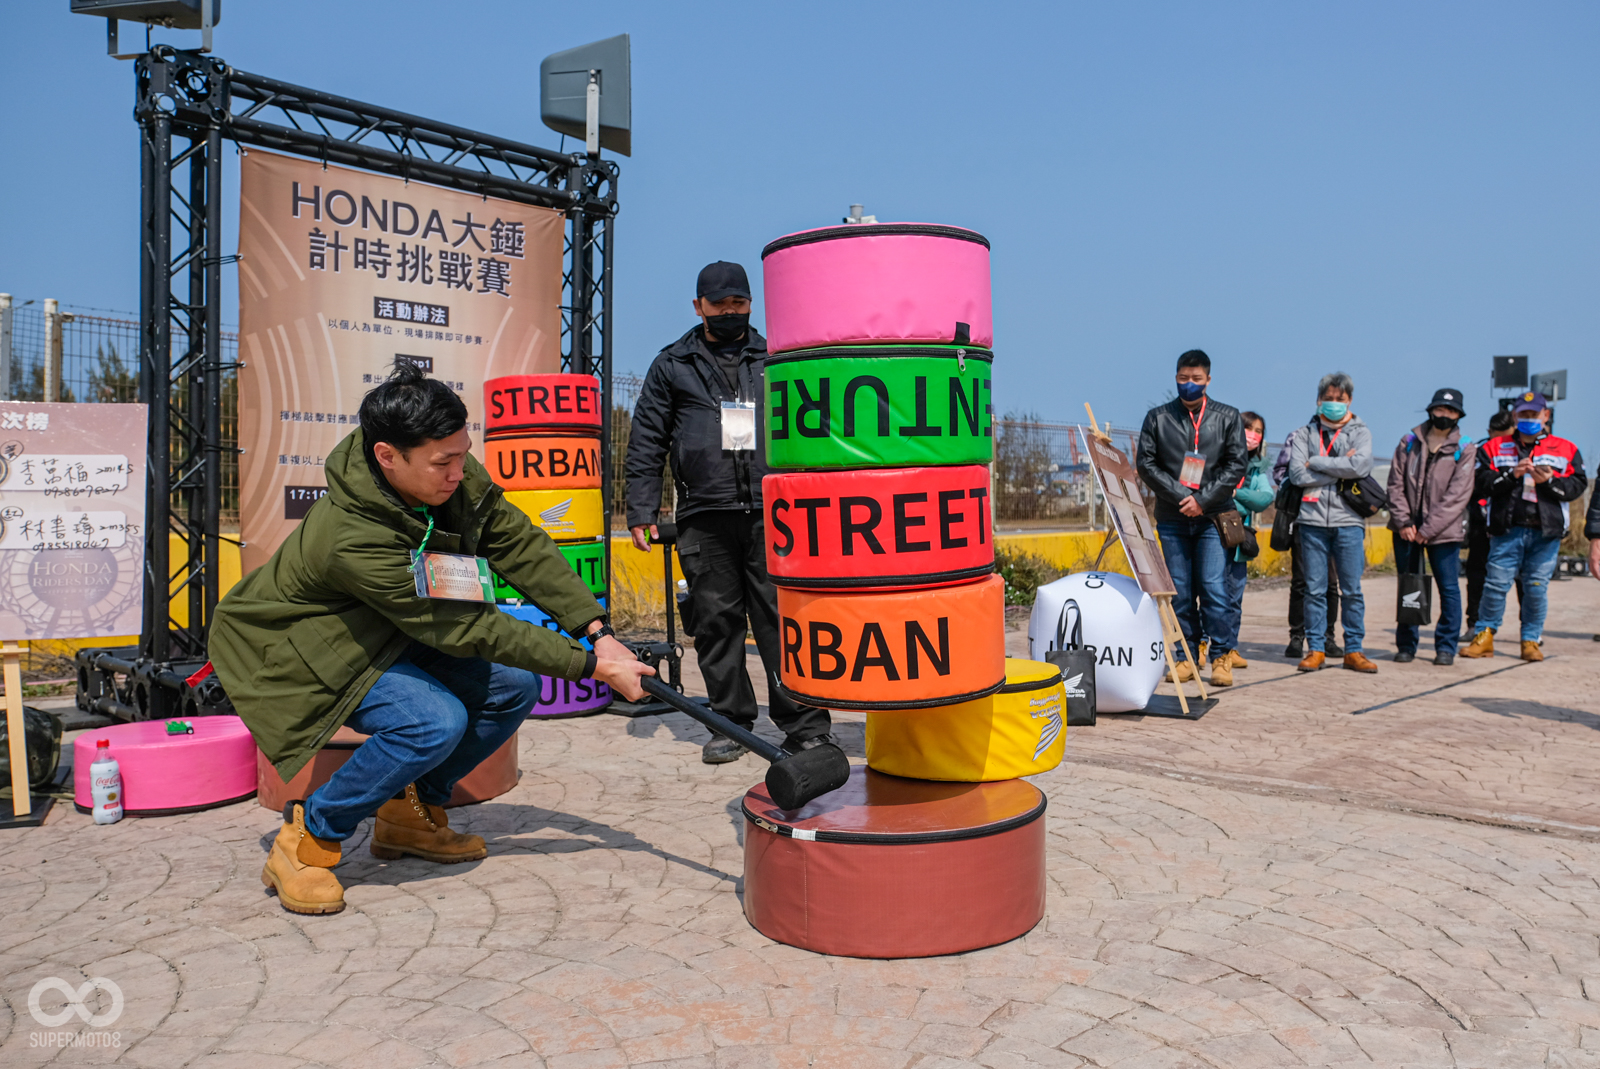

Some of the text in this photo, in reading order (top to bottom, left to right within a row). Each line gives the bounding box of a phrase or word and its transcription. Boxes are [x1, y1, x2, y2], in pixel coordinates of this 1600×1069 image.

[308, 227, 511, 298] 計時挑戰賽
[378, 300, 446, 325] 活動辦法
[491, 385, 599, 419] STREET
[1, 412, 49, 431] 次榜
[498, 448, 600, 480] URBAN
[771, 487, 988, 557] STREET
[33, 561, 112, 575] HONDA
[84, 576, 112, 586] DAY
[783, 616, 950, 682] RBAN
